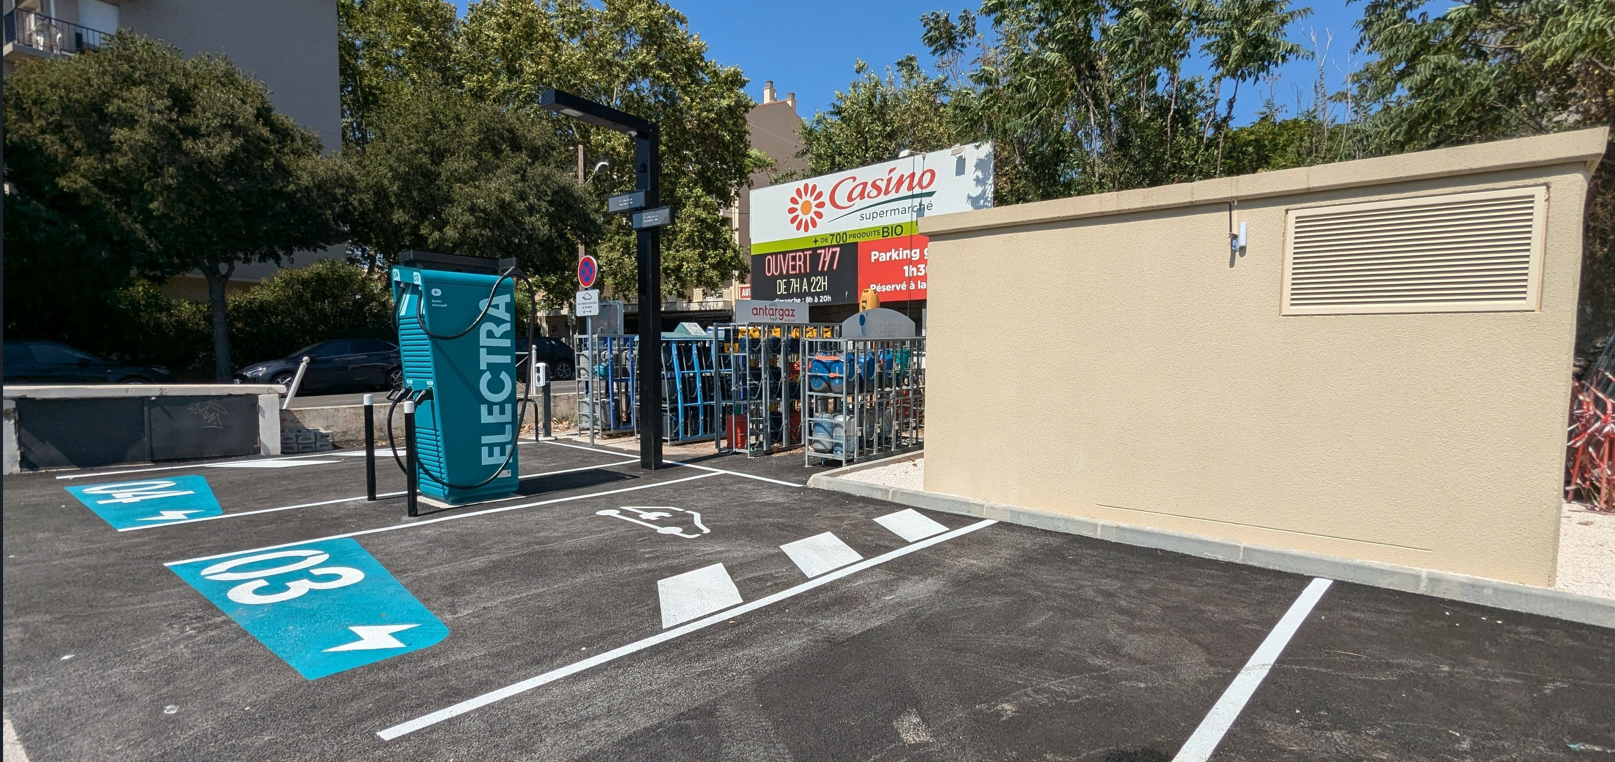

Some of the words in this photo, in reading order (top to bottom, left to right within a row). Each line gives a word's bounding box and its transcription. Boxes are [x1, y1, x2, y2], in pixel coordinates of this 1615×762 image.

[828, 166, 936, 210] Casino
[859, 200, 934, 221] supermarché
[820, 236, 829, 244] DE
[829, 231, 848, 245] 700
[848, 229, 881, 240] PRODUITS
[881, 224, 904, 238] BIO
[765, 250, 813, 277] OUVERT
[870, 247, 921, 263] Parking
[902, 263, 928, 278] 1h3
[776, 279, 788, 295] DE
[789, 278, 800, 294] 7H
[802, 277, 809, 292] A
[810, 275, 828, 292] 22H
[909, 280, 915, 290] à
[917, 280, 927, 290] la
[819, 294, 832, 303] 20h
[751, 305, 796, 321] antargaz
[478, 293, 513, 466] ELECTRA
[82, 480, 195, 505] 04
[200, 549, 365, 605] 03
